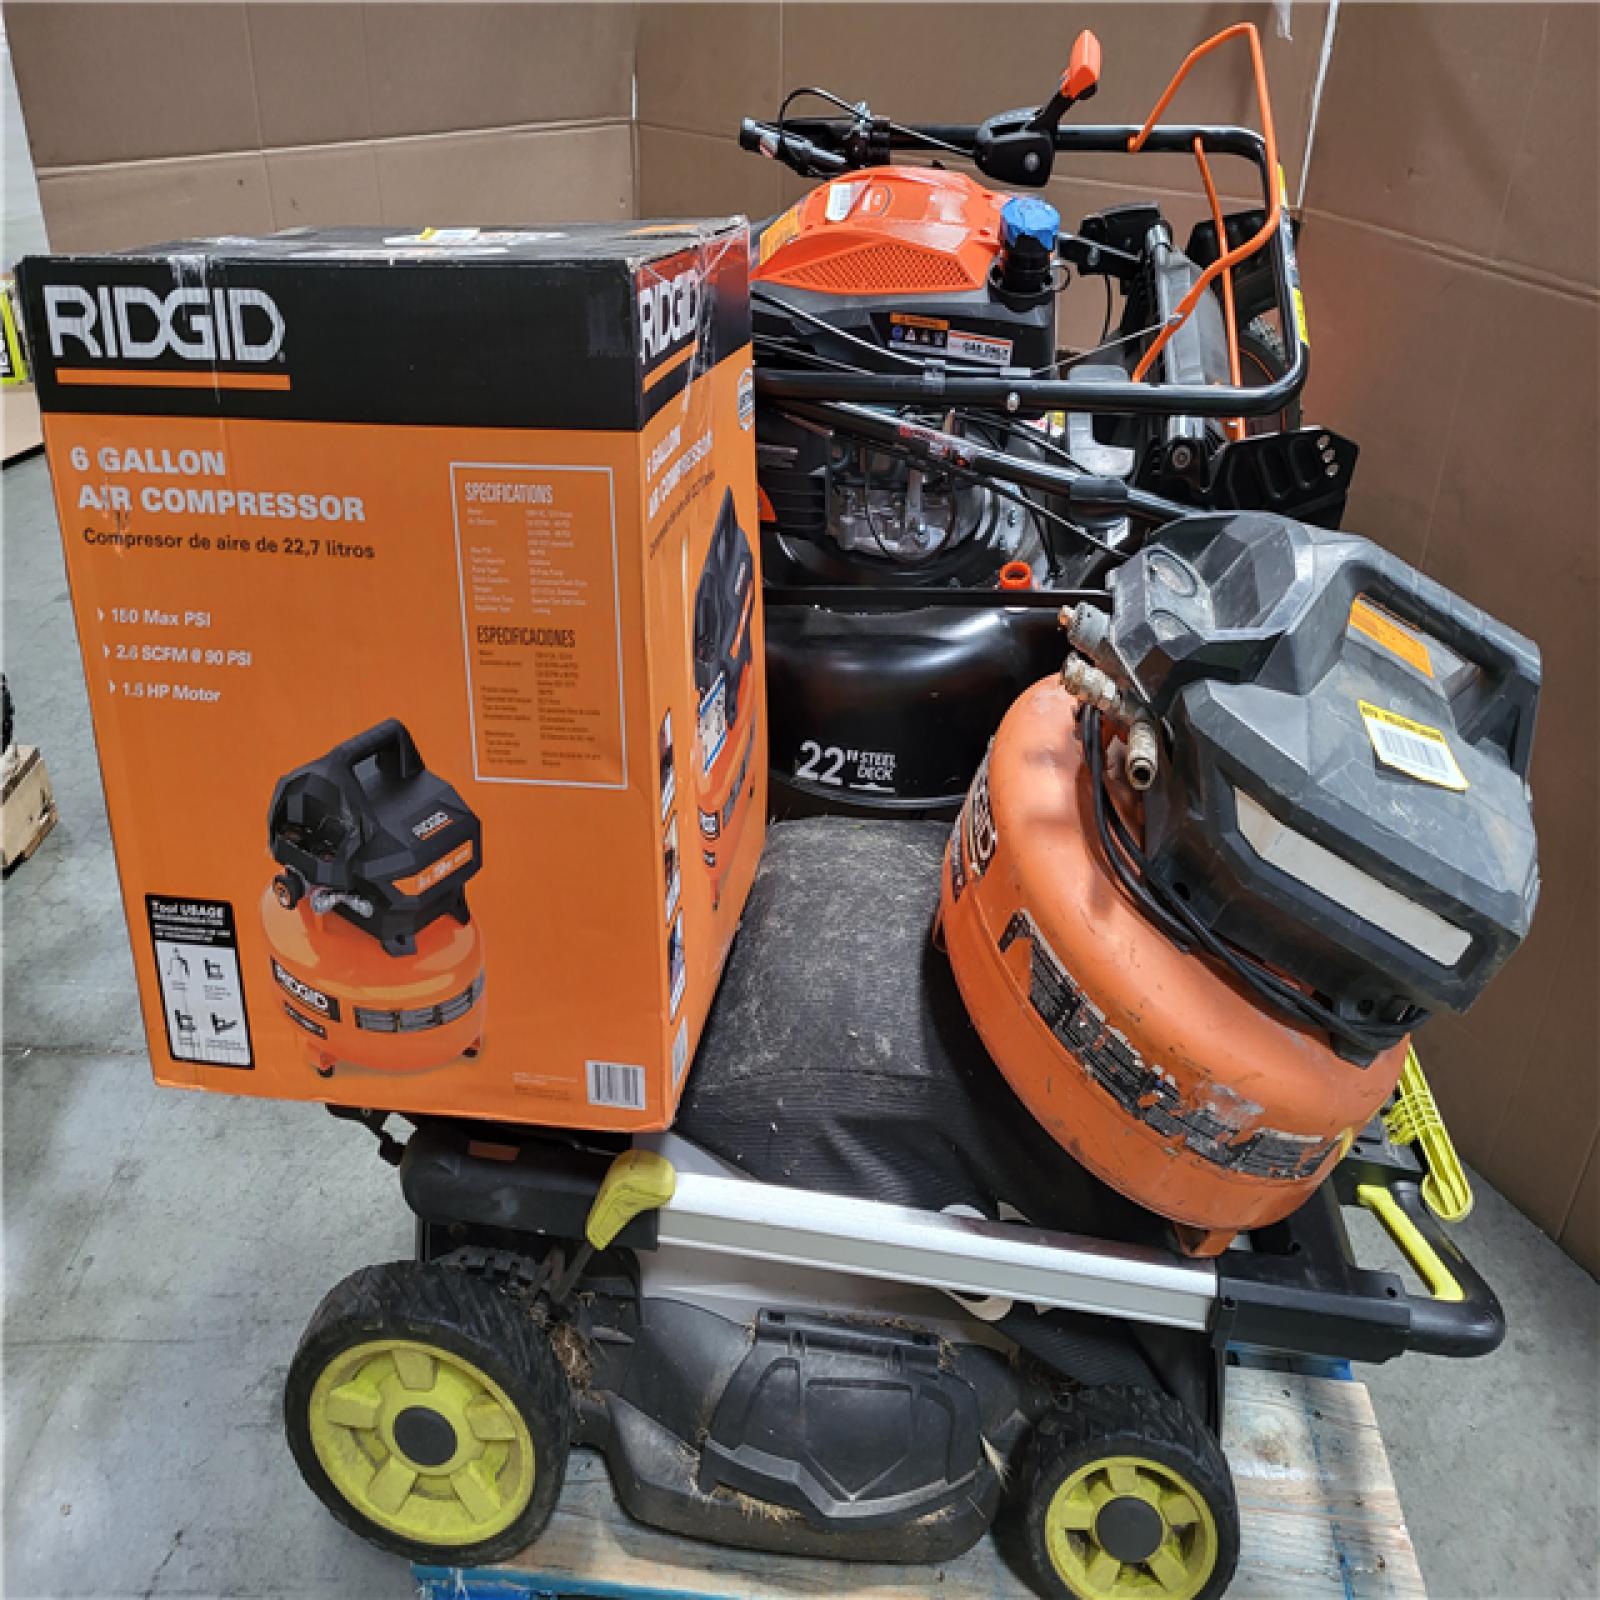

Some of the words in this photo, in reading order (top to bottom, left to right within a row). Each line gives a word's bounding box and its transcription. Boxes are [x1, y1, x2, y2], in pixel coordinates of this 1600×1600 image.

[44, 284, 286, 362] RIDGID
[71, 448, 89, 471] 6
[98, 448, 226, 476] GALLON
[78, 484, 132, 511] AIR
[140, 487, 366, 521] COMPRESSOR
[83, 527, 183, 551] Compresor
[189, 532, 211, 551] de
[216, 532, 249, 551] aire
[255, 535, 278, 553] de
[283, 536, 320, 558] 22,7
[325, 540, 375, 558] litros
[143, 609, 179, 626] Max
[184, 611, 211, 628] PSI
[142, 645, 188, 662] SCFM
[227, 650, 252, 666] PSI
[147, 683, 170, 698] HP
[172, 684, 221, 702] Motor
